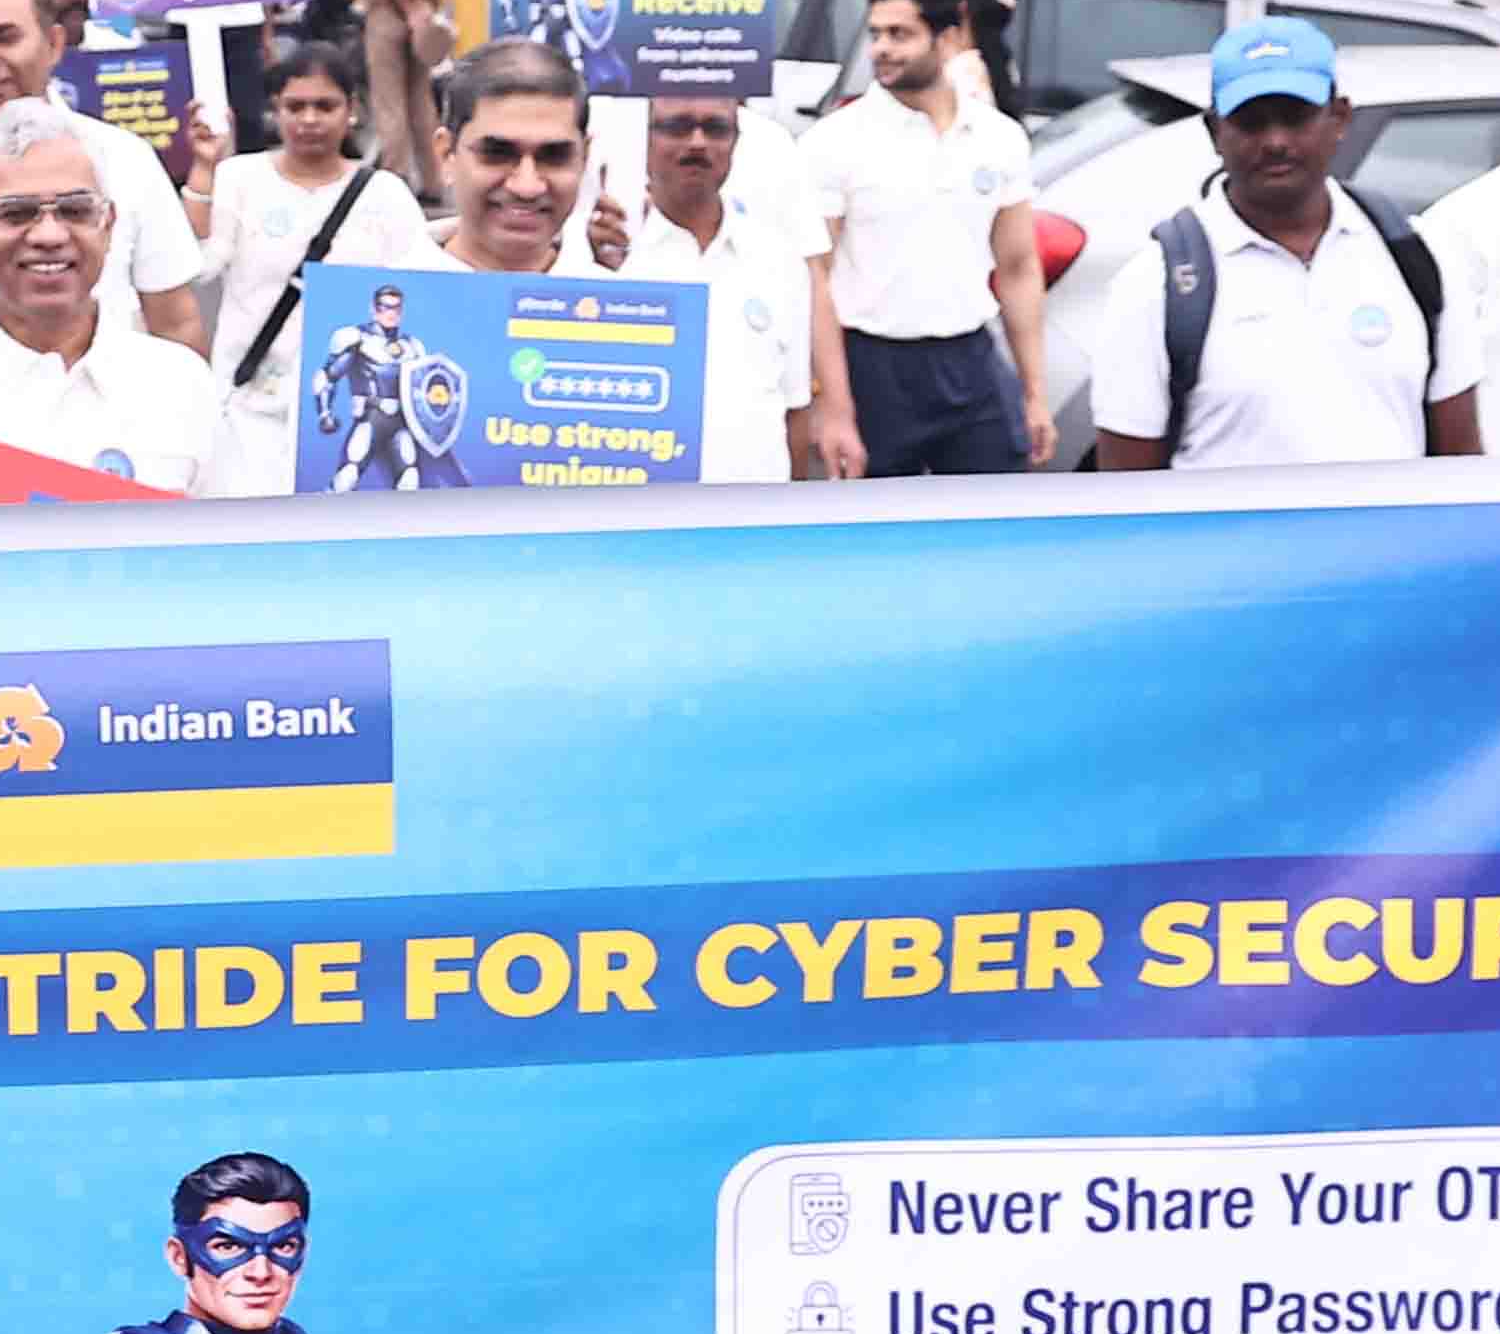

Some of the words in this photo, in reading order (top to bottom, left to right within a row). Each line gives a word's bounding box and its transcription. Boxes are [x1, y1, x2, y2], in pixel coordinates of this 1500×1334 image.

[485, 416, 553, 447] Use
[555, 420, 686, 462] strong,
[99, 703, 233, 743] Indian
[245, 697, 356, 738] Bank
[407, 931, 655, 1019] FOR
[698, 910, 1102, 1007] CYBER
[890, 1180, 1062, 1235] Never
[1085, 1176, 1254, 1233] Share
[1280, 1172, 1413, 1226] Your
